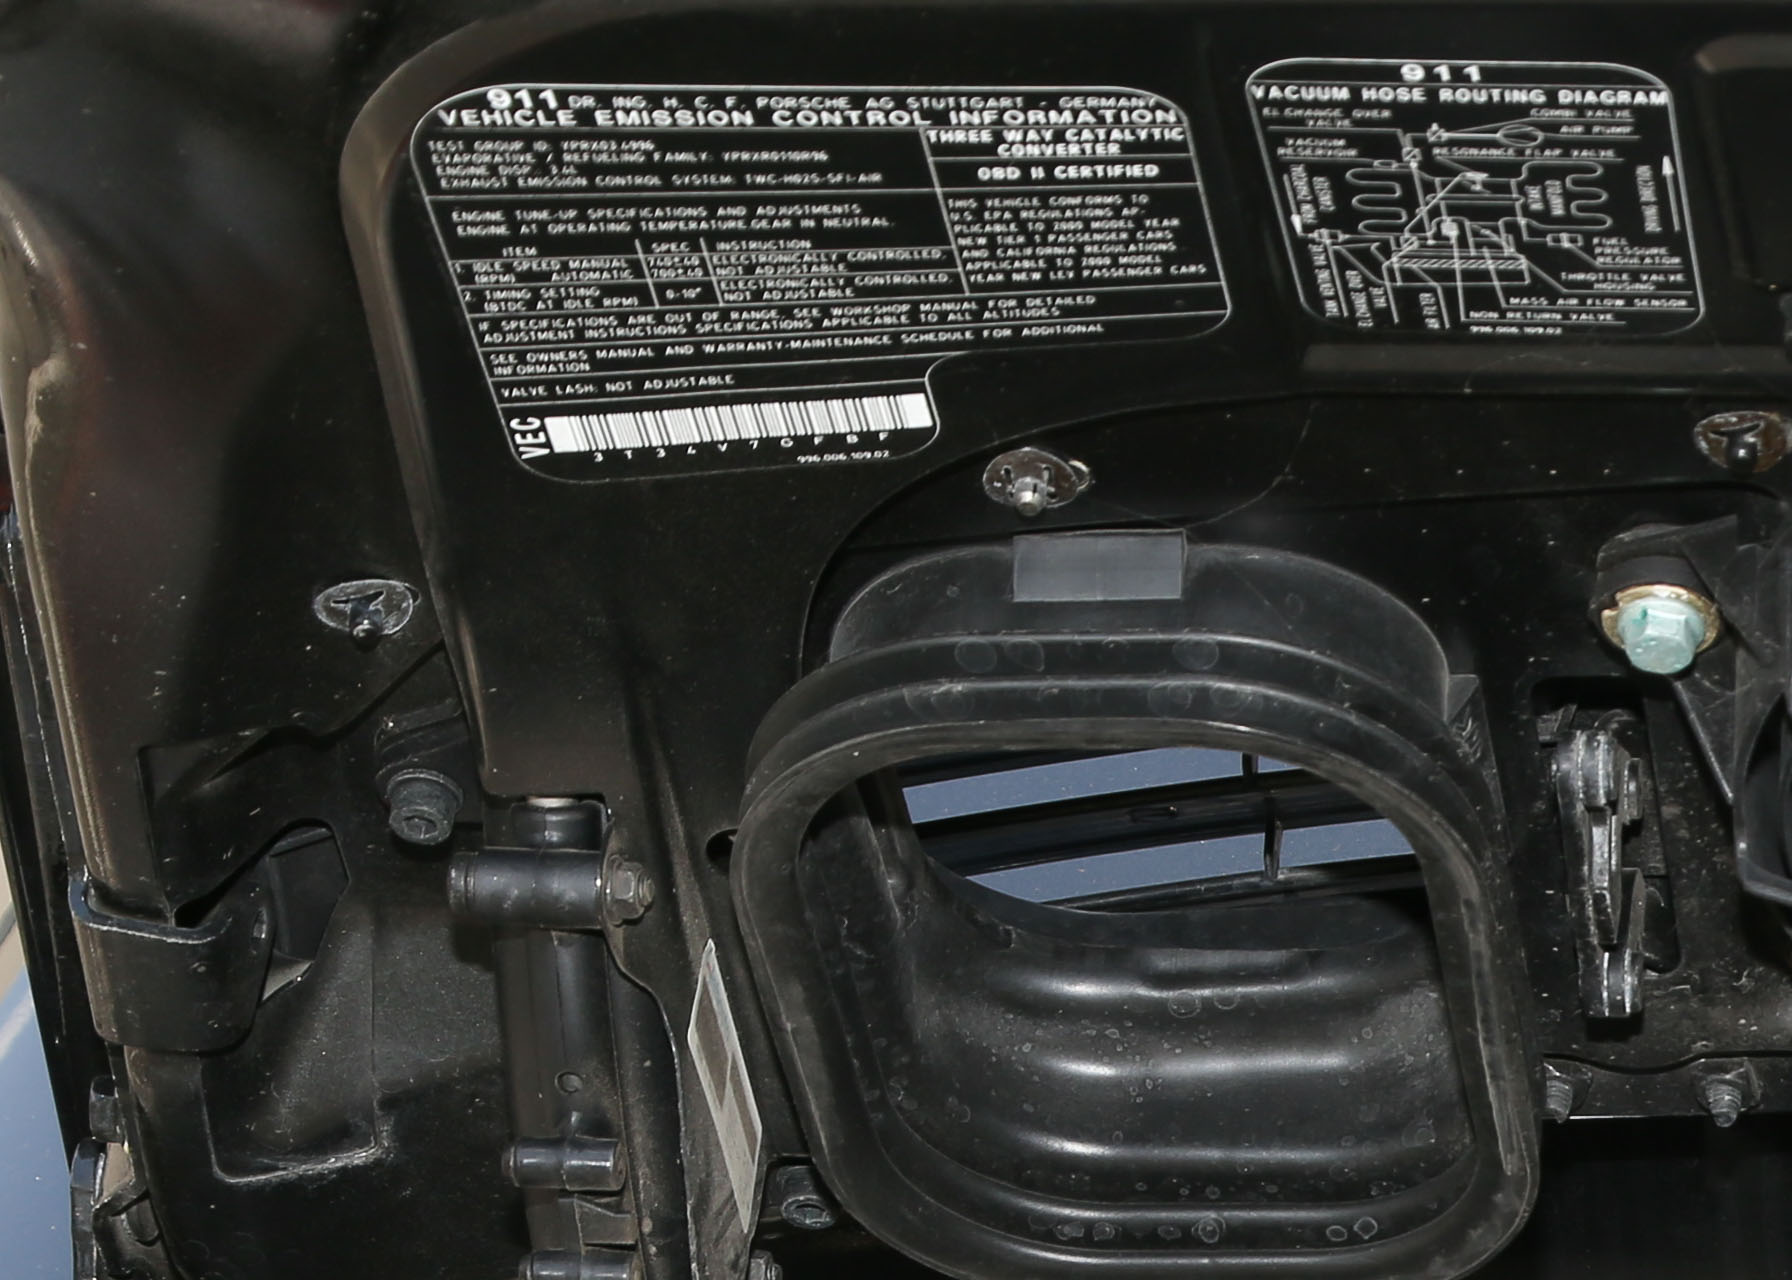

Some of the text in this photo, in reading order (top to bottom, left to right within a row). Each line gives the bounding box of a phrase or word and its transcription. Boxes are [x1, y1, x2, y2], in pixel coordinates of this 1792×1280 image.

[1400, 63, 1481, 82] 911
[486, 88, 559, 110] 911
[754, 96, 851, 107] PORSCHE
[863, 97, 895, 107] AG
[905, 97, 1025, 107] STUTTGART
[1056, 97, 1158, 106] GERMANY
[1251, 85, 1669, 105] VACUUM HOSE ROUTING DIAGRAM
[437, 110, 1182, 126] VEHICLE EMISSION CONTROL INFORMATION
[926, 128, 1185, 142] THREE WAY CATALYTIC
[996, 143, 1121, 156] CONVERTER
[976, 166, 1022, 180] OBD
[1052, 164, 1160, 179] CERTIFIED
[439, 177, 508, 188] EXHAUST
[516, 176, 589, 187] EMISSION
[594, 176, 662, 186] CONTROL
[450, 204, 862, 221] ENGINE TUNE-UP SPECIFICATIONS AND ADJUSTMENTS
[455, 225, 510, 236] ENGINE
[518, 225, 538, 235] AT
[546, 223, 633, 234] OPERATING
[799, 219, 817, 229] IN
[501, 247, 538, 257] ITEM
[650, 242, 690, 252] SPEC
[715, 239, 812, 251] INSTRUCTION
[477, 322, 491, 332] IF
[500, 316, 619, 331] SPECIFICATIONS
[625, 314, 656, 325] ARE
[663, 313, 693, 324] OUT
[700, 311, 721, 322] OF
[792, 307, 821, 318] SEE
[829, 303, 912, 316] WORKSHOP
[918, 300, 978, 312] MANUAL
[986, 298, 1018, 309] FOR
[1024, 295, 1097, 307] DETAILED
[482, 307, 1061, 344] ADJUSTMENT INSTRUCTIONS SPECIFICATIONS APPLICABLE TO ALL ALTITUDES
[488, 353, 518, 363] SEE
[524, 349, 588, 361] OWNERS
[594, 346, 654, 358] MANUAL
[663, 344, 695, 354] AND
[899, 330, 974, 342] SCHEDULE
[981, 328, 1013, 338] FOR
[1019, 323, 1104, 336] ADDITIONAL
[492, 362, 591, 376] INFORMATION
[500, 384, 547, 397] VALVE
[604, 380, 633, 391] NOT
[641, 374, 734, 389] ADJUSTABLE
[509, 415, 550, 459] VEC
